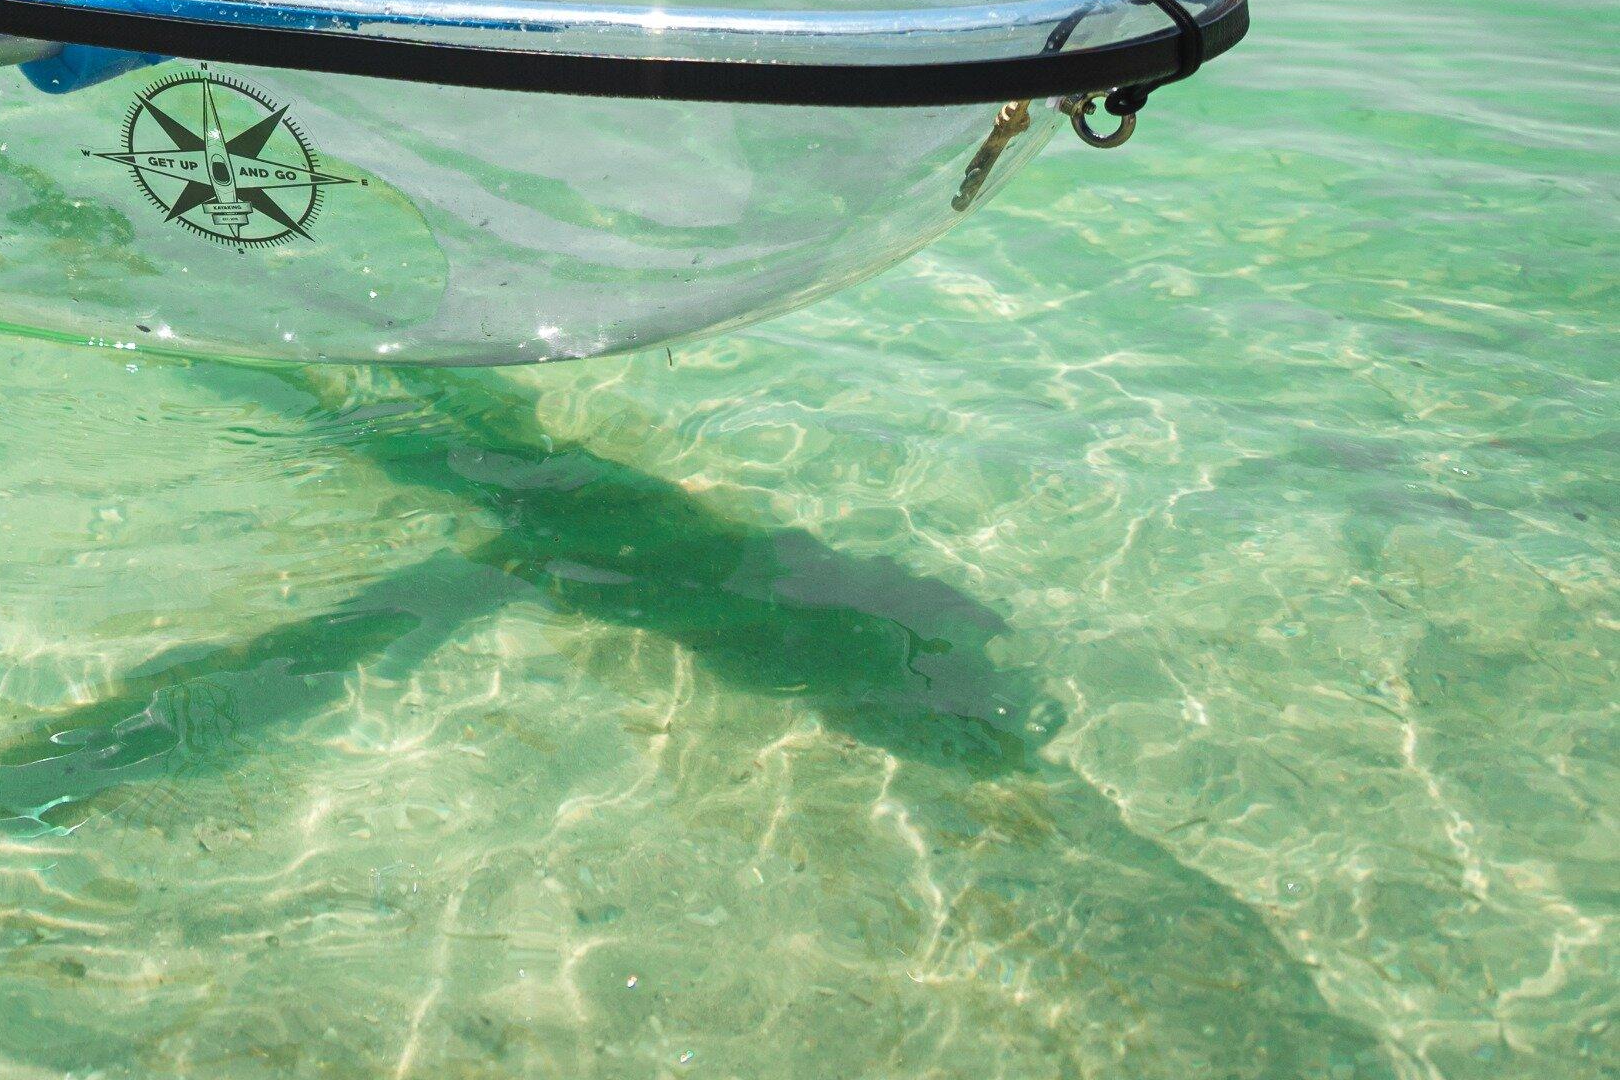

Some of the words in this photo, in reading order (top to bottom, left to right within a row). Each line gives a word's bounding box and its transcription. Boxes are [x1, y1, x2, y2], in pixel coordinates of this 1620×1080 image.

[200, 62, 208, 71] N
[147, 156, 175, 169] GET
[180, 160, 198, 171] UP
[239, 166, 269, 179] AND
[274, 170, 297, 181] GO
